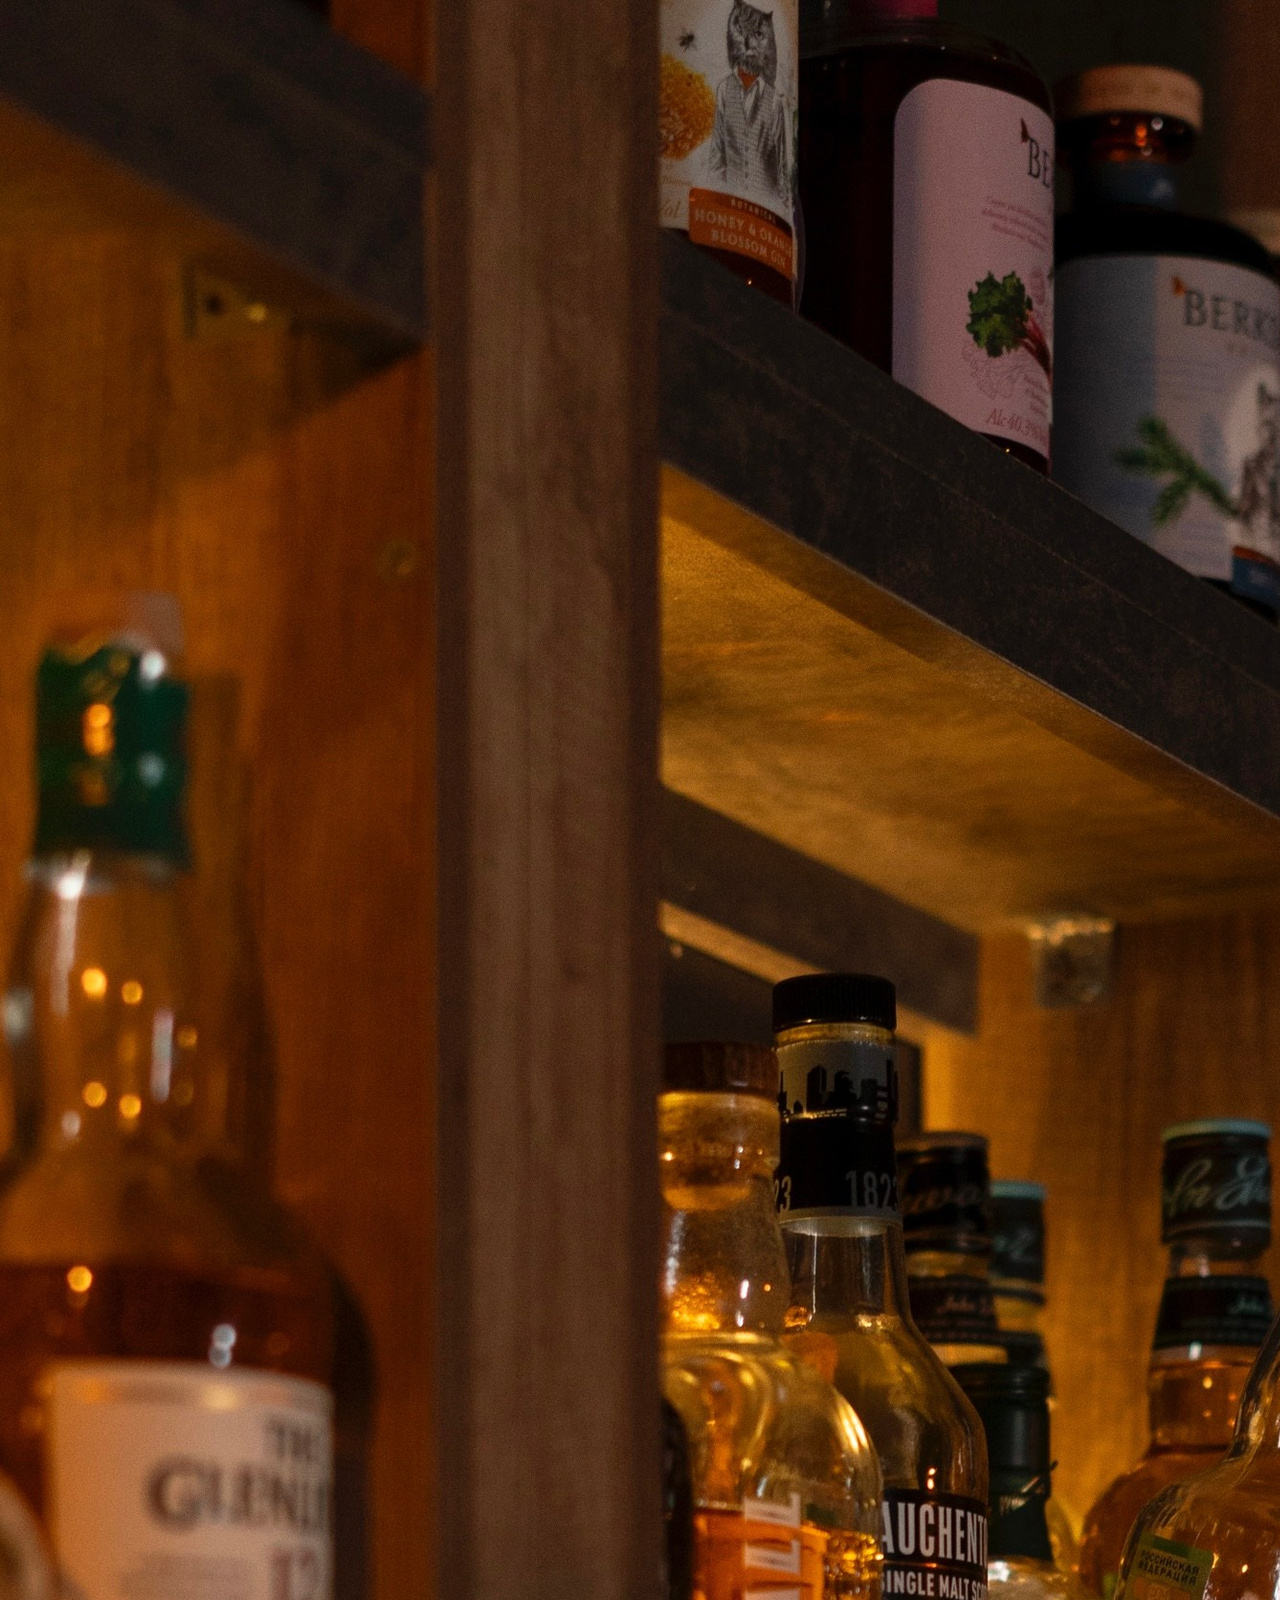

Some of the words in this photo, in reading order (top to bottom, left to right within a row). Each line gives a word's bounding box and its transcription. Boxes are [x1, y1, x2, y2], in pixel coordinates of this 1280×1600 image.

[694, 208, 745, 231] HONEY
[711, 228, 768, 256] BLOSSOM
[771, 250, 786, 268] GIN
[1138, 1560, 1197, 1586] ФЕДЕРАЦИЯ
[1140, 1549, 1200, 1575] РОССИЙСКАЯ
